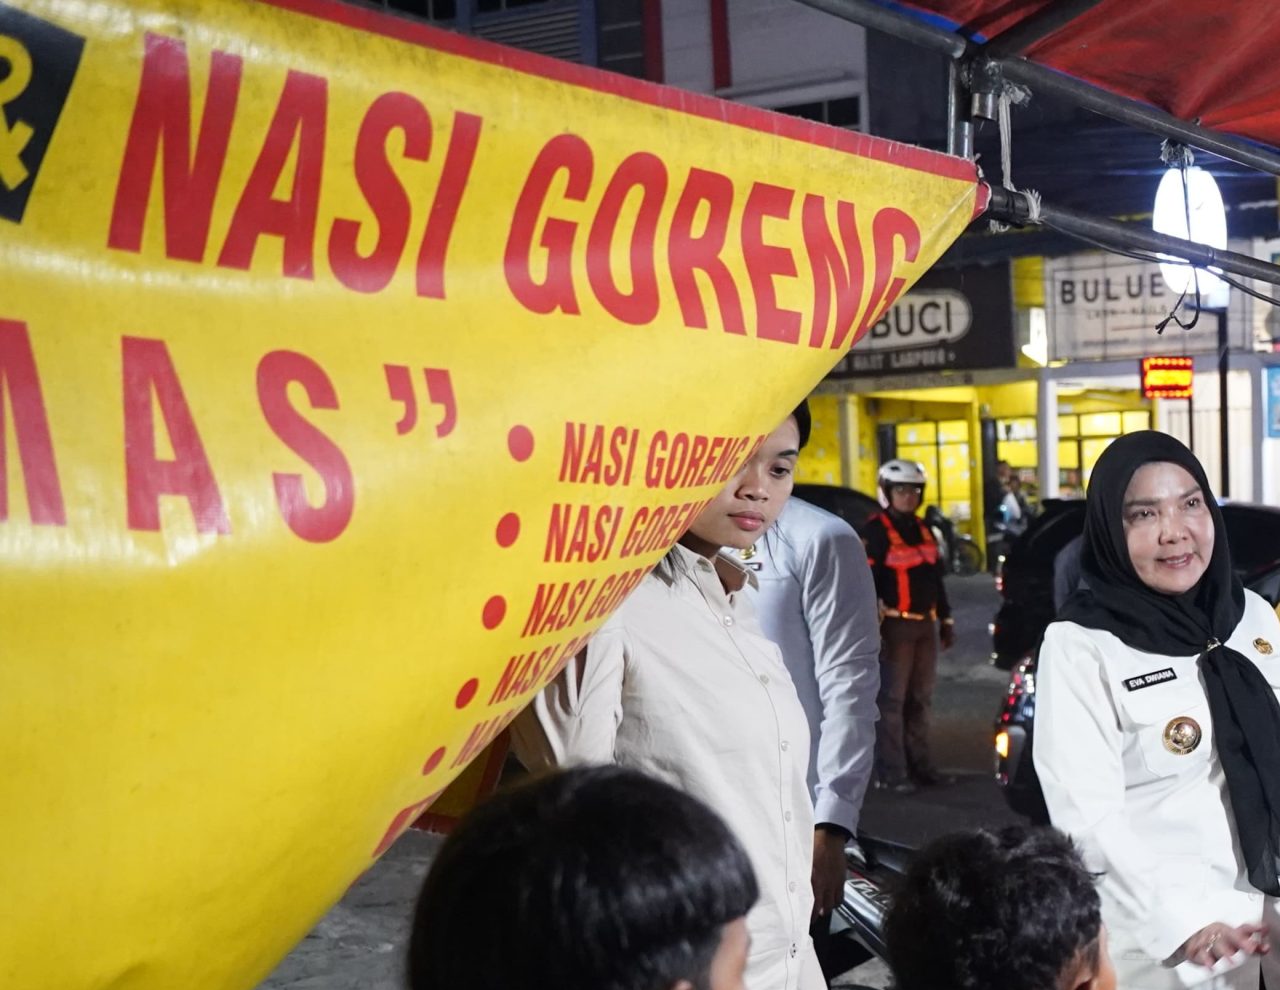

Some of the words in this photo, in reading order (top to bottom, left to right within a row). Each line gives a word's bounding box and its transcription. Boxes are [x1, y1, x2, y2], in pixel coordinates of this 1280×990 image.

[107, 30, 483, 299] NASI
[504, 133, 921, 349] GORENG
[558, 421, 640, 489] NASI
[645, 430, 750, 489] GORENG
[544, 503, 623, 563] NASI
[520, 578, 596, 638] NASI
[488, 643, 561, 706] NASI
[1129, 677, 1144, 688] EVA
[1147, 670, 1174, 682] DWIANA
